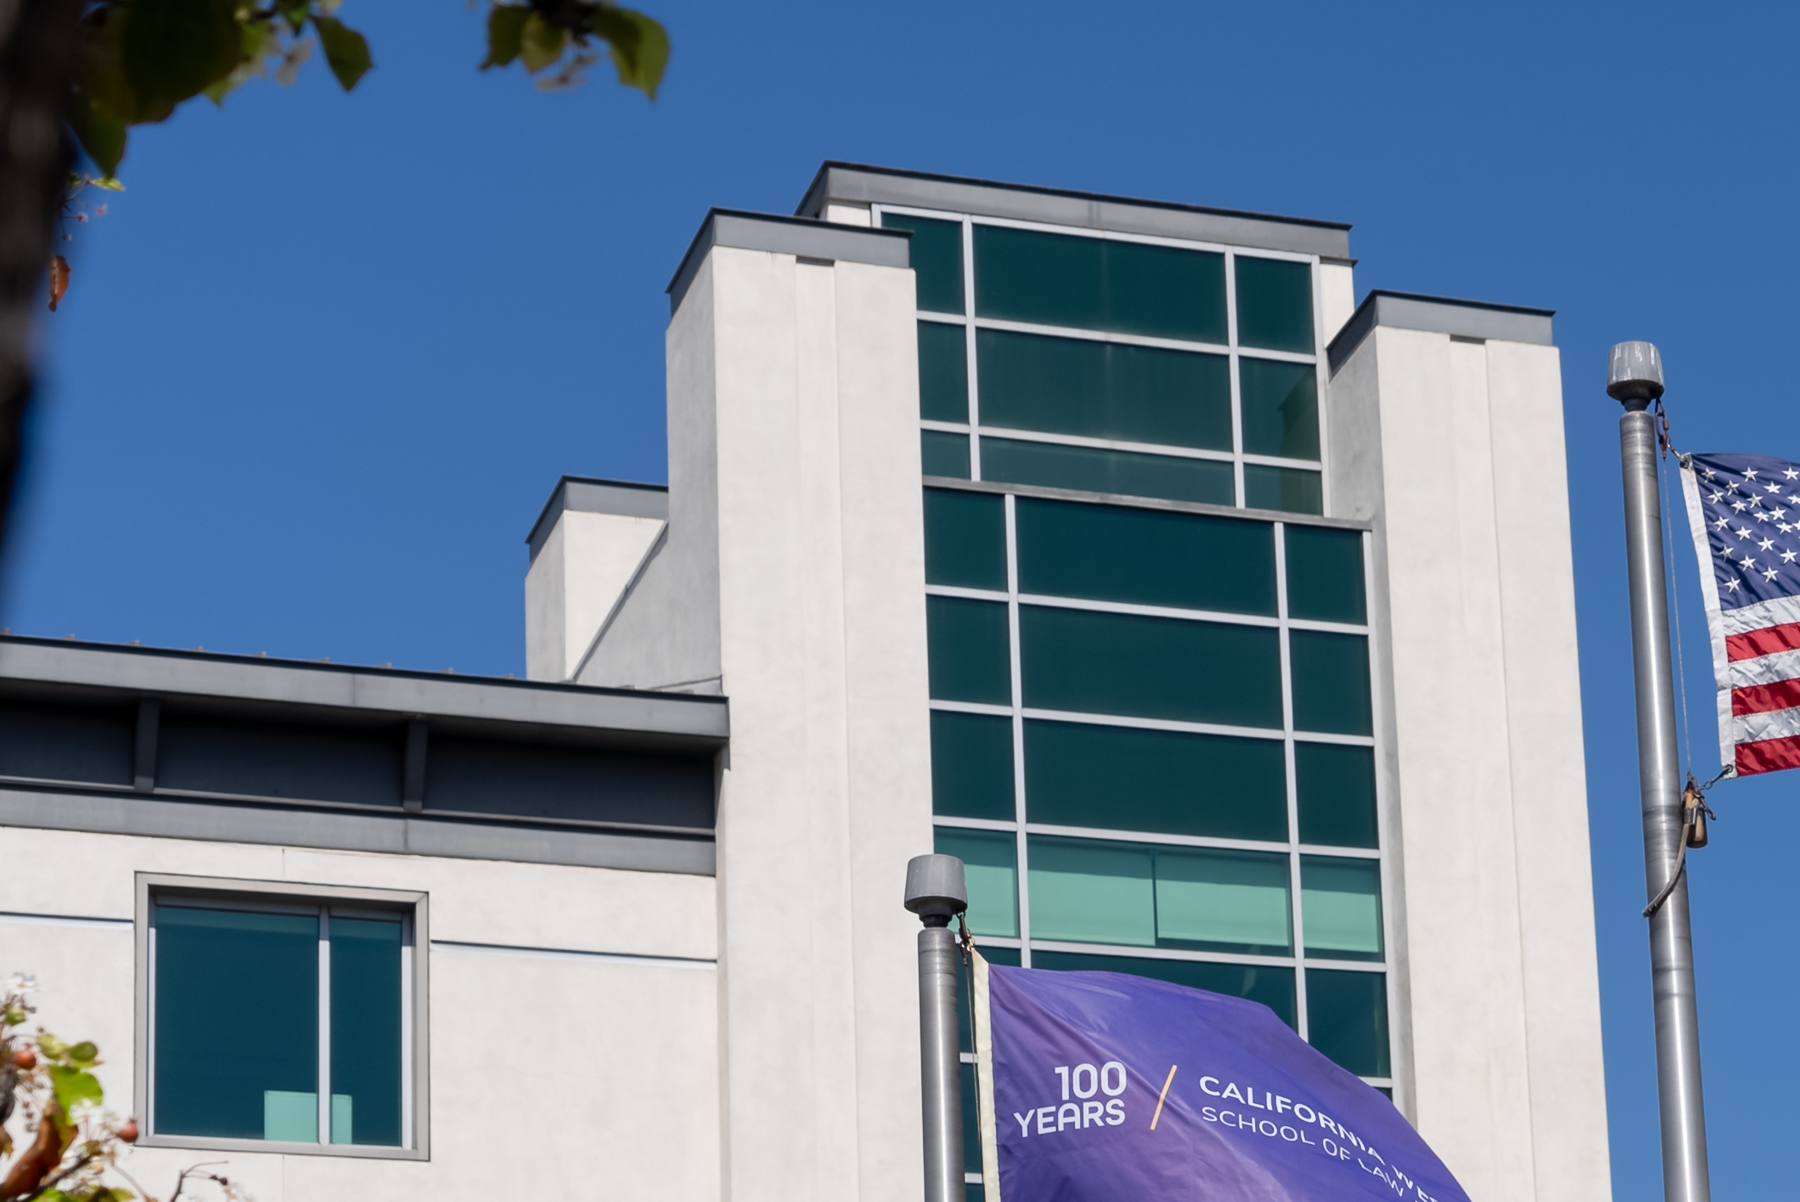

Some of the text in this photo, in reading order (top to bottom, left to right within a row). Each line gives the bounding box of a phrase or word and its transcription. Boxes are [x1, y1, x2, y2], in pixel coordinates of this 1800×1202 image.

[1054, 1061, 1127, 1101] 100
[1013, 1098, 1126, 1138] YEARS
[1200, 1076, 1386, 1165] CALIFORNIA
[1201, 1106, 1315, 1146] SCHOOL
[1322, 1138, 1351, 1161] OF
[1358, 1158, 1403, 1197] LAW
